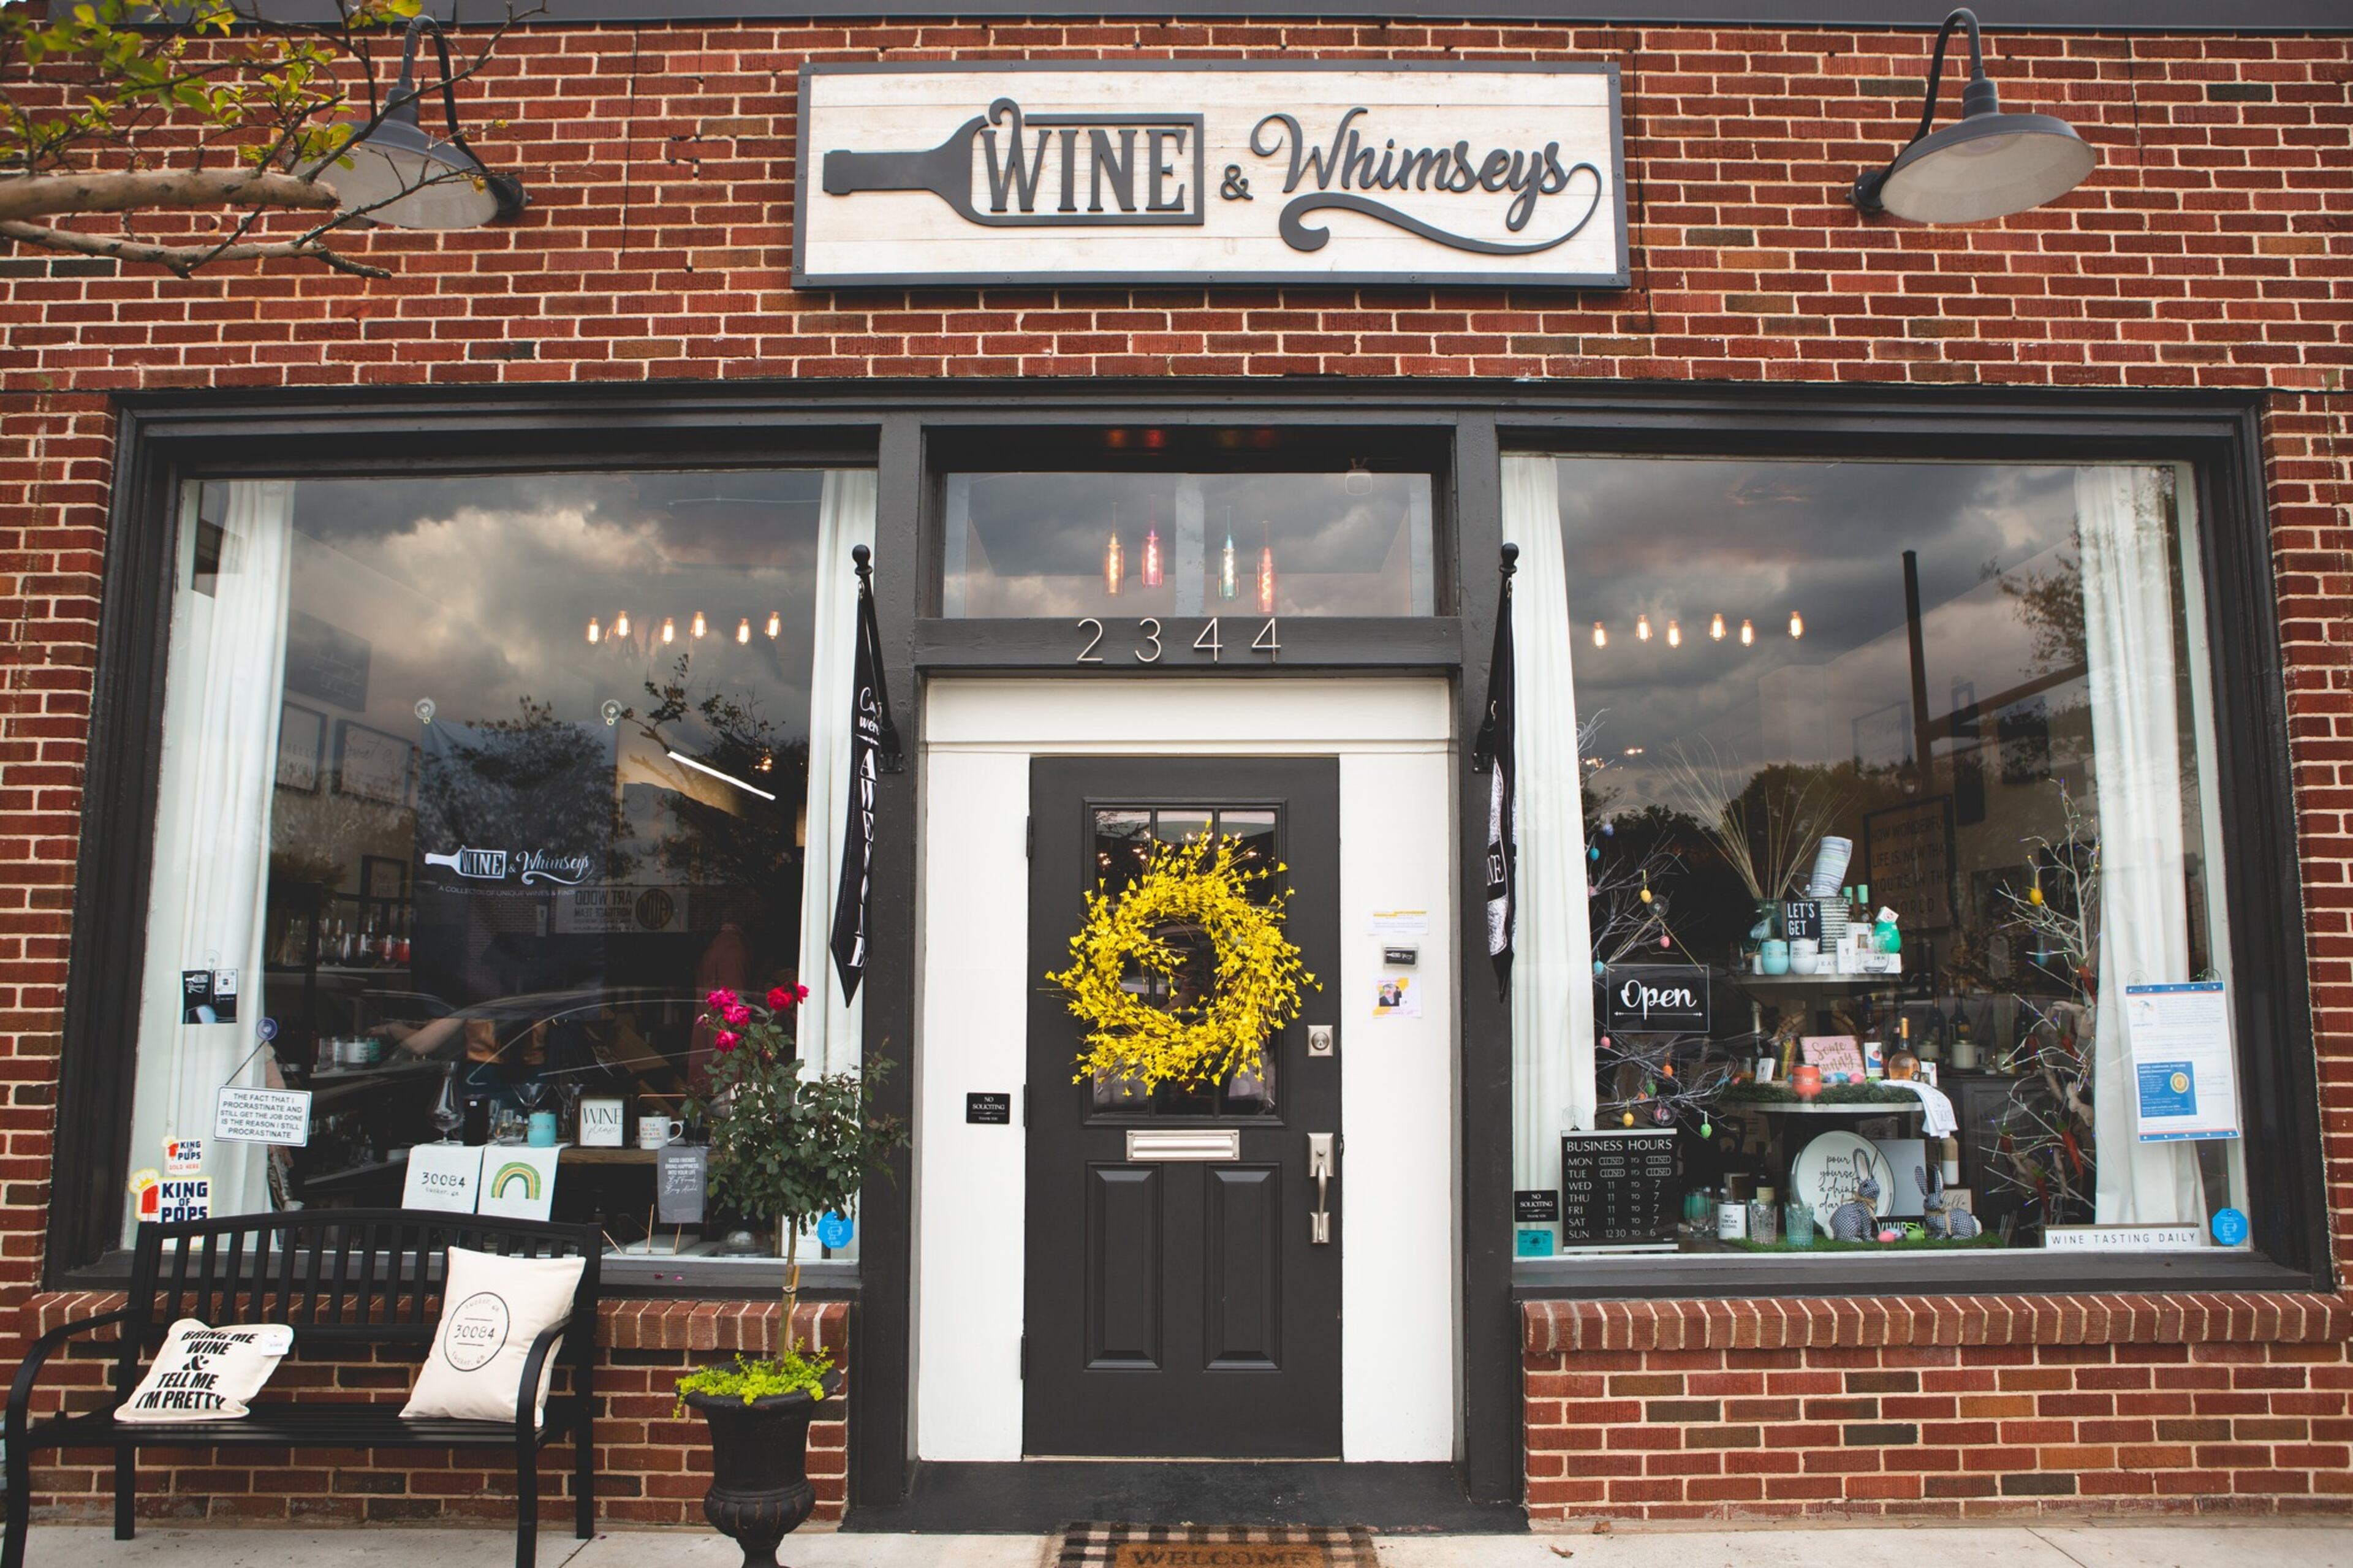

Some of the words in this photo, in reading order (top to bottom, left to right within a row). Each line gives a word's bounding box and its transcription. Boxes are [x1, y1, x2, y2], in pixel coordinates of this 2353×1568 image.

[982, 98, 1187, 213] WINE
[1221, 164, 1254, 200] &
[1250, 107, 1602, 254] Whimseys
[1892, 814, 1944, 837] WONDERFU
[460, 845, 502, 875] WINE
[508, 865, 517, 873] &
[1787, 903, 1815, 918] LET'S
[1788, 920, 1807, 936] GET
[1621, 979, 1697, 1020] Open
[1811, 1042, 1847, 1061] Some
[223, 1101, 285, 1112] PROCRASTINATE
[583, 1108, 623, 1124] WINE
[229, 1127, 292, 1138] PROCRASTINATE
[1566, 1140, 1623, 1152] BUSINESS
[1627, 1138, 1672, 1151] HOURS
[1567, 1157, 1593, 1166] MON
[1598, 1156, 1624, 1165] CLOSED
[1646, 1155, 1672, 1164] CLOSED
[1826, 1155, 1851, 1170] pour
[422, 1172, 466, 1187] 30084
[1568, 1170, 1587, 1178] TUE
[1600, 1168, 1625, 1178] CLOSED
[1646, 1167, 1672, 1176] CLOSED
[1818, 1170, 1855, 1187] yourse
[162, 1182, 208, 1198] KING
[1568, 1181, 1592, 1191] WED
[1655, 1180, 1661, 1189] 7
[179, 1198, 191, 1206] OF
[1569, 1194, 1590, 1203] THU
[1608, 1193, 1615, 1202] 11
[1654, 1192, 1659, 1200] 7
[162, 1206, 208, 1223] POPS
[1568, 1206, 1583, 1214] FRI
[1653, 1204, 1659, 1213] 7
[1568, 1218, 1586, 1227] SAT
[1653, 1216, 1659, 1225] 7
[1568, 1230, 1590, 1239] SUN
[1650, 1229, 1656, 1237] 6
[2051, 1235, 2084, 1244] WINE
[2094, 1233, 2150, 1243] TASTING
[2159, 1232, 2196, 1242] DAILY
[181, 1330, 230, 1341] BRING
[230, 1333, 258, 1344] ME
[453, 1325, 495, 1339] 30084
[186, 1341, 233, 1355] WINE
[182, 1355, 210, 1371] &
[156, 1372, 190, 1388] TELL
[189, 1373, 219, 1390] ME
[135, 1391, 162, 1409] I'M
[162, 1391, 226, 1409] PRETTY
[1133, 1551, 1311, 1566] WELCOME
